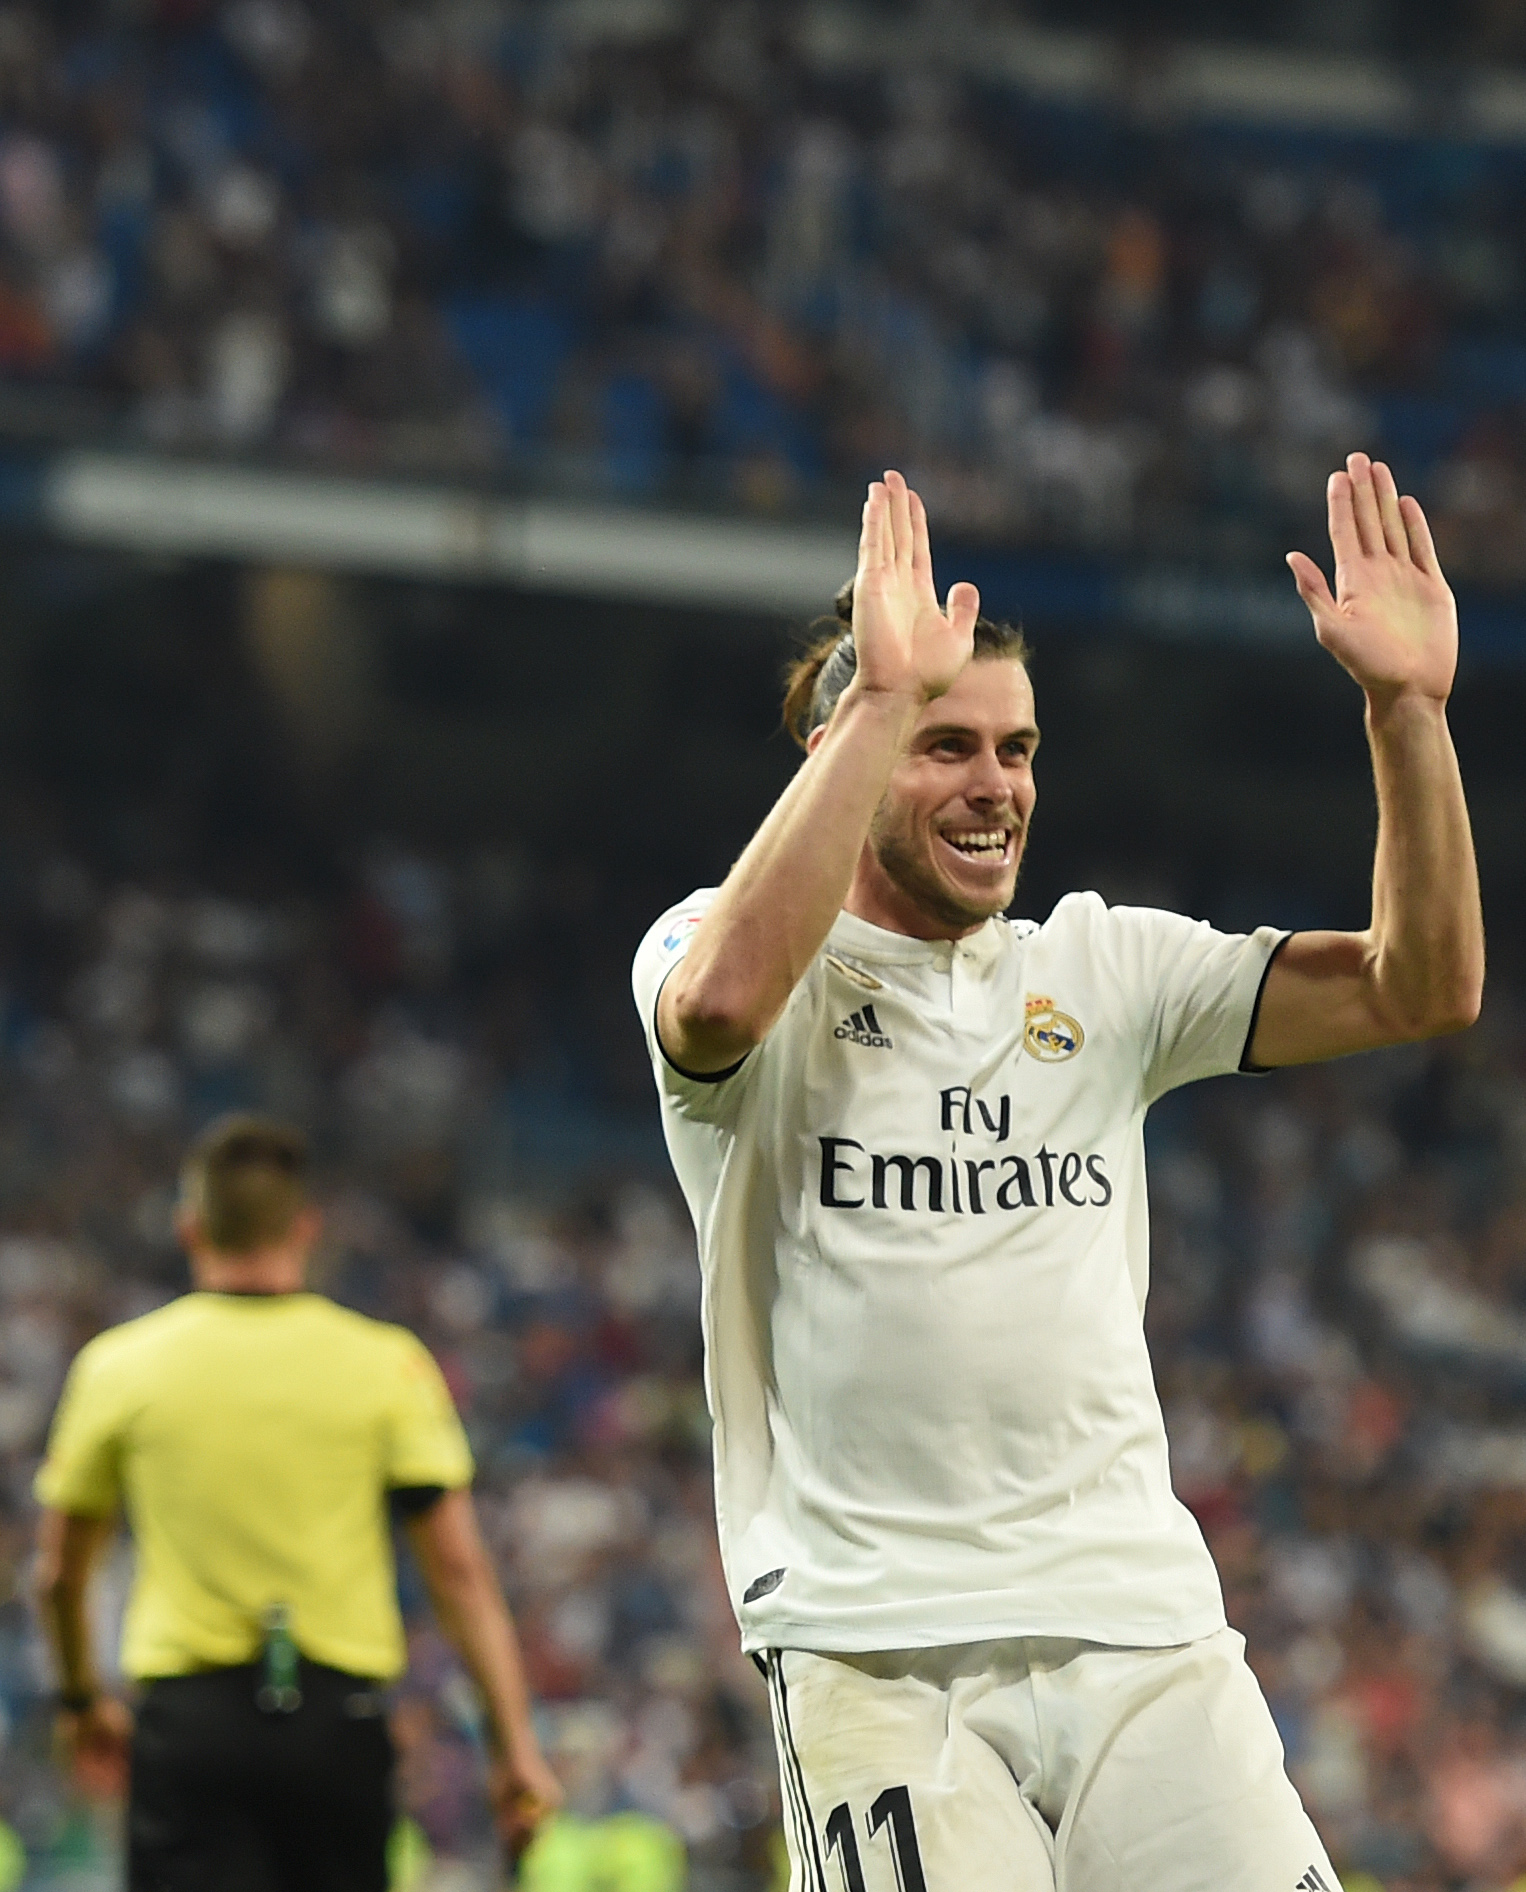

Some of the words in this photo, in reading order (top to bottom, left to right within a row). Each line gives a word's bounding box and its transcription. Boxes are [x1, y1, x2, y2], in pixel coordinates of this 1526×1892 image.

[834, 1026, 893, 1049] adidas
[939, 1086, 1010, 1142] Fly
[818, 1136, 1112, 1214] Emirates
[822, 1784, 928, 1892] 11
